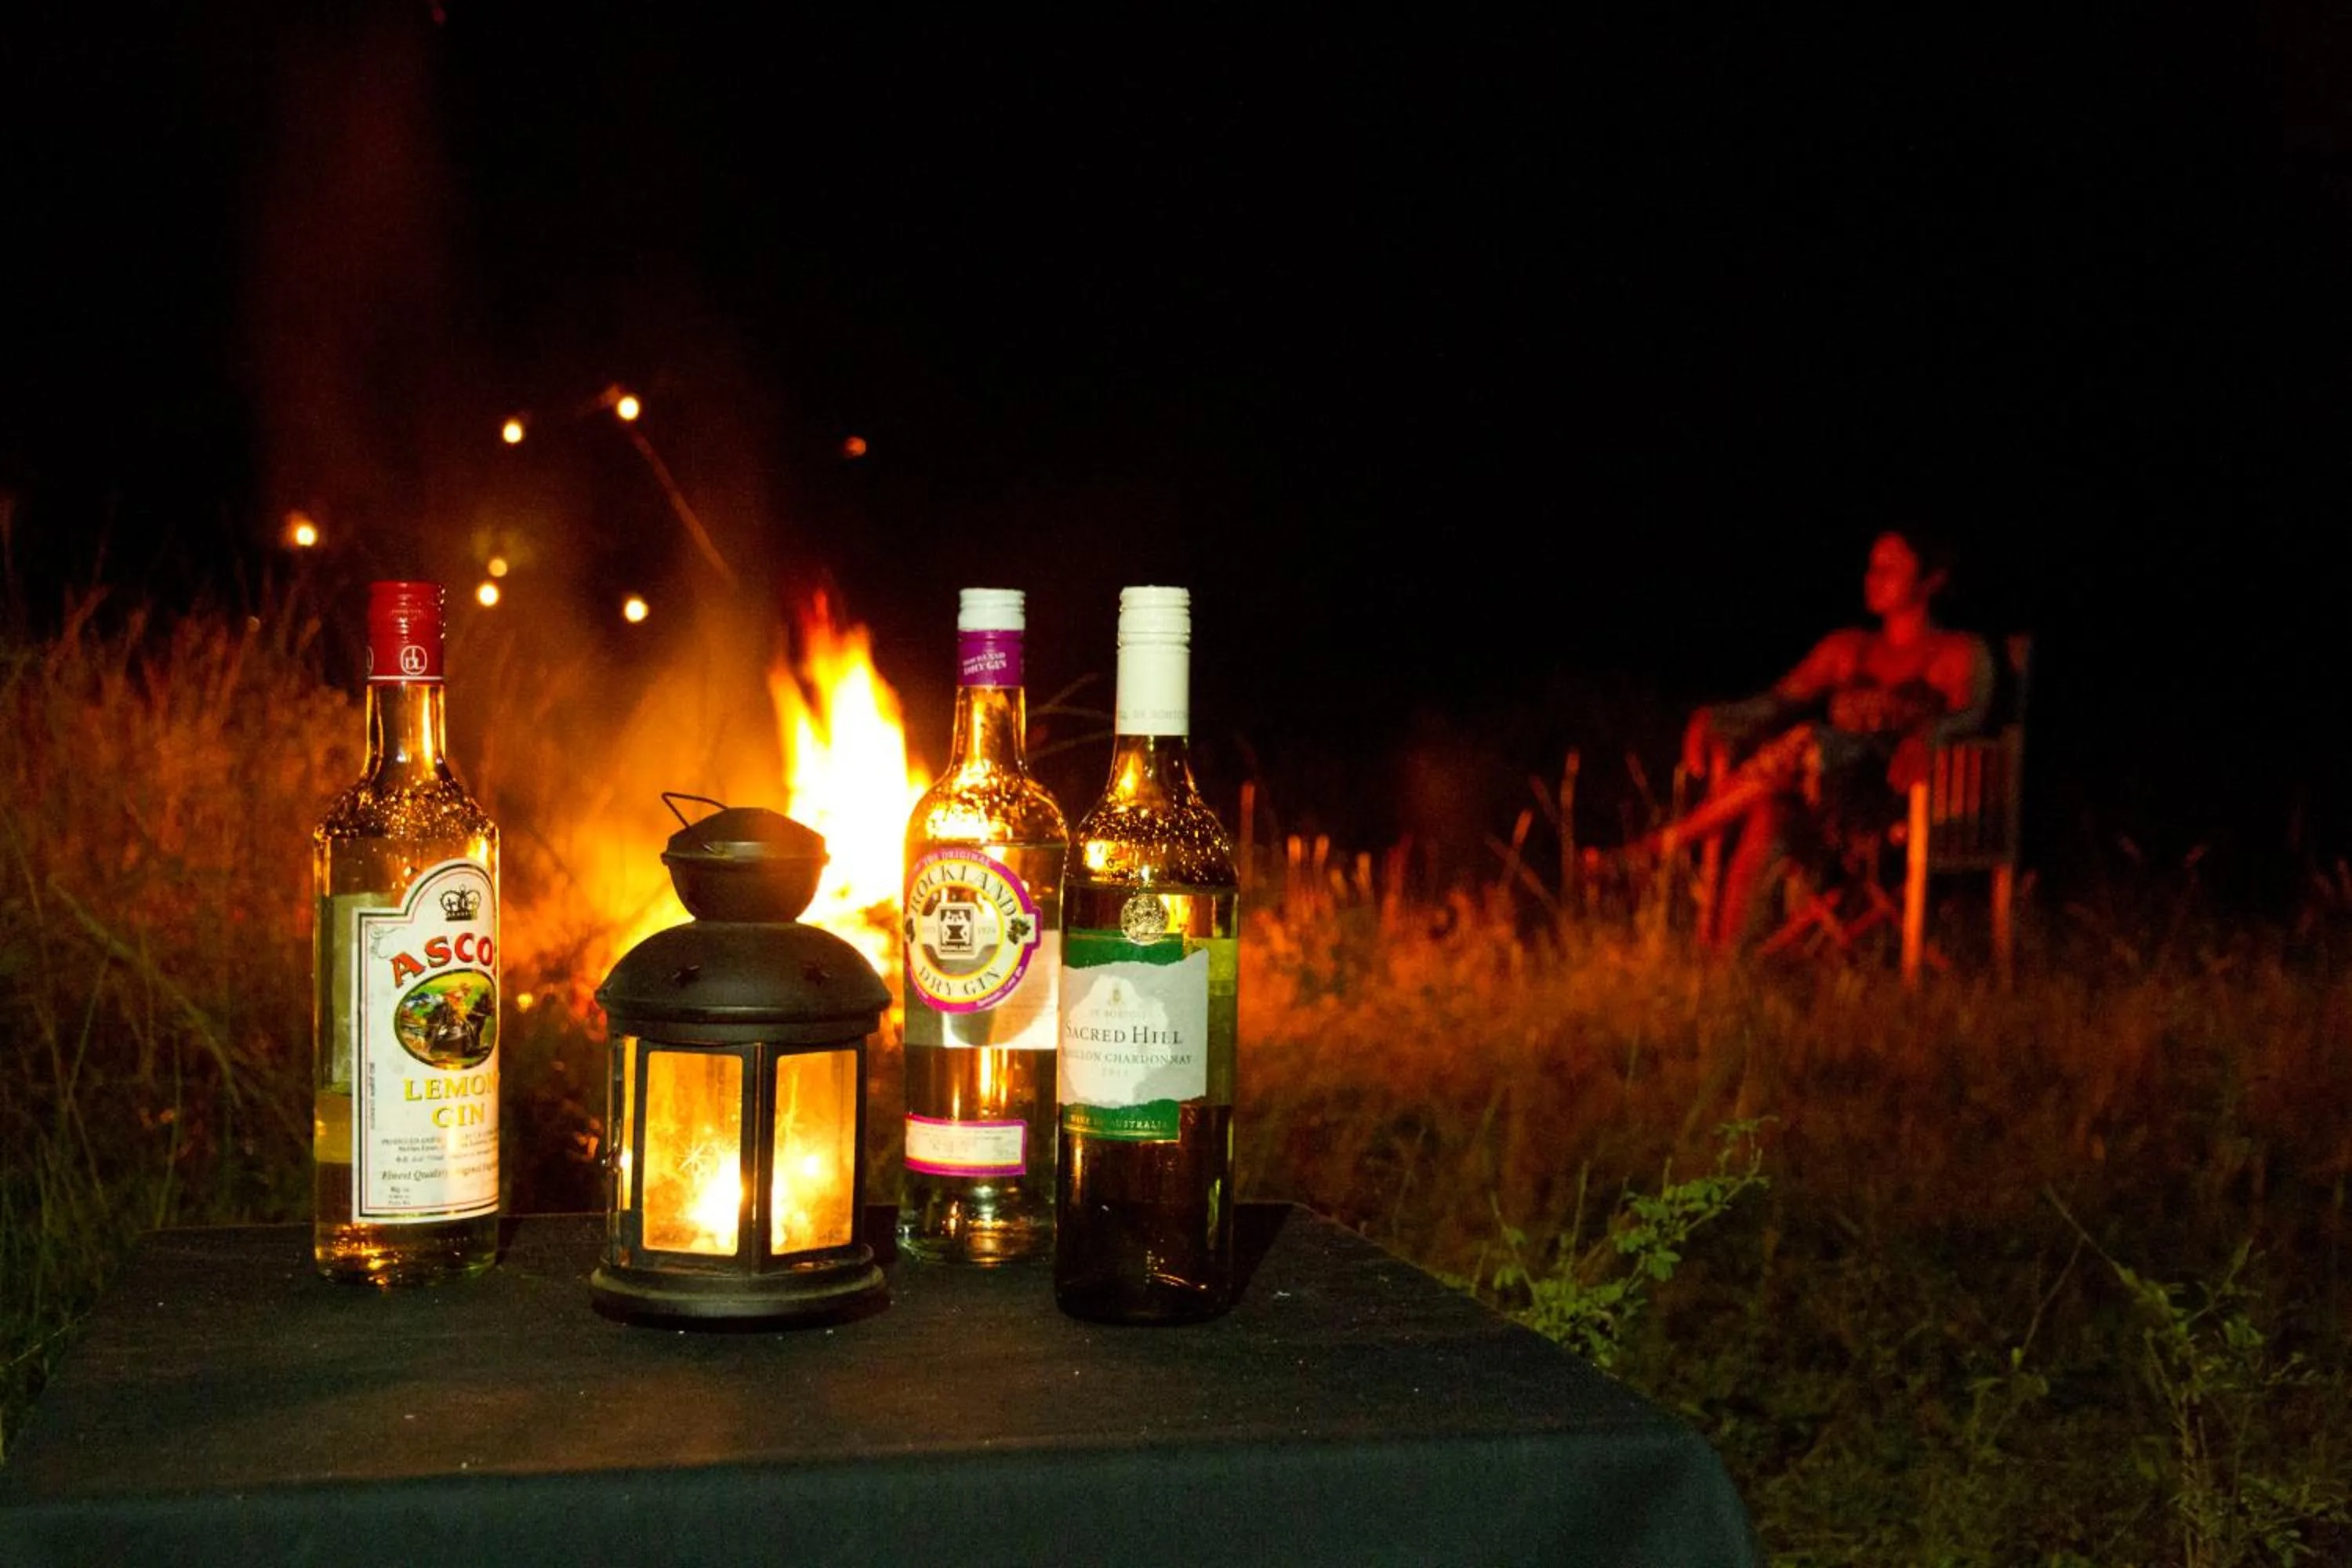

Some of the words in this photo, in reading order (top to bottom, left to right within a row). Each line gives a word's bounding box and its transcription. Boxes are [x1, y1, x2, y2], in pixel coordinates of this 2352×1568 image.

[390, 932, 496, 989] ASCO
[919, 967, 952, 996] DRY
[963, 971, 1000, 996] GIN
[1105, 1052, 1192, 1065] CHARDONNAY
[432, 1103, 486, 1128] GIN
